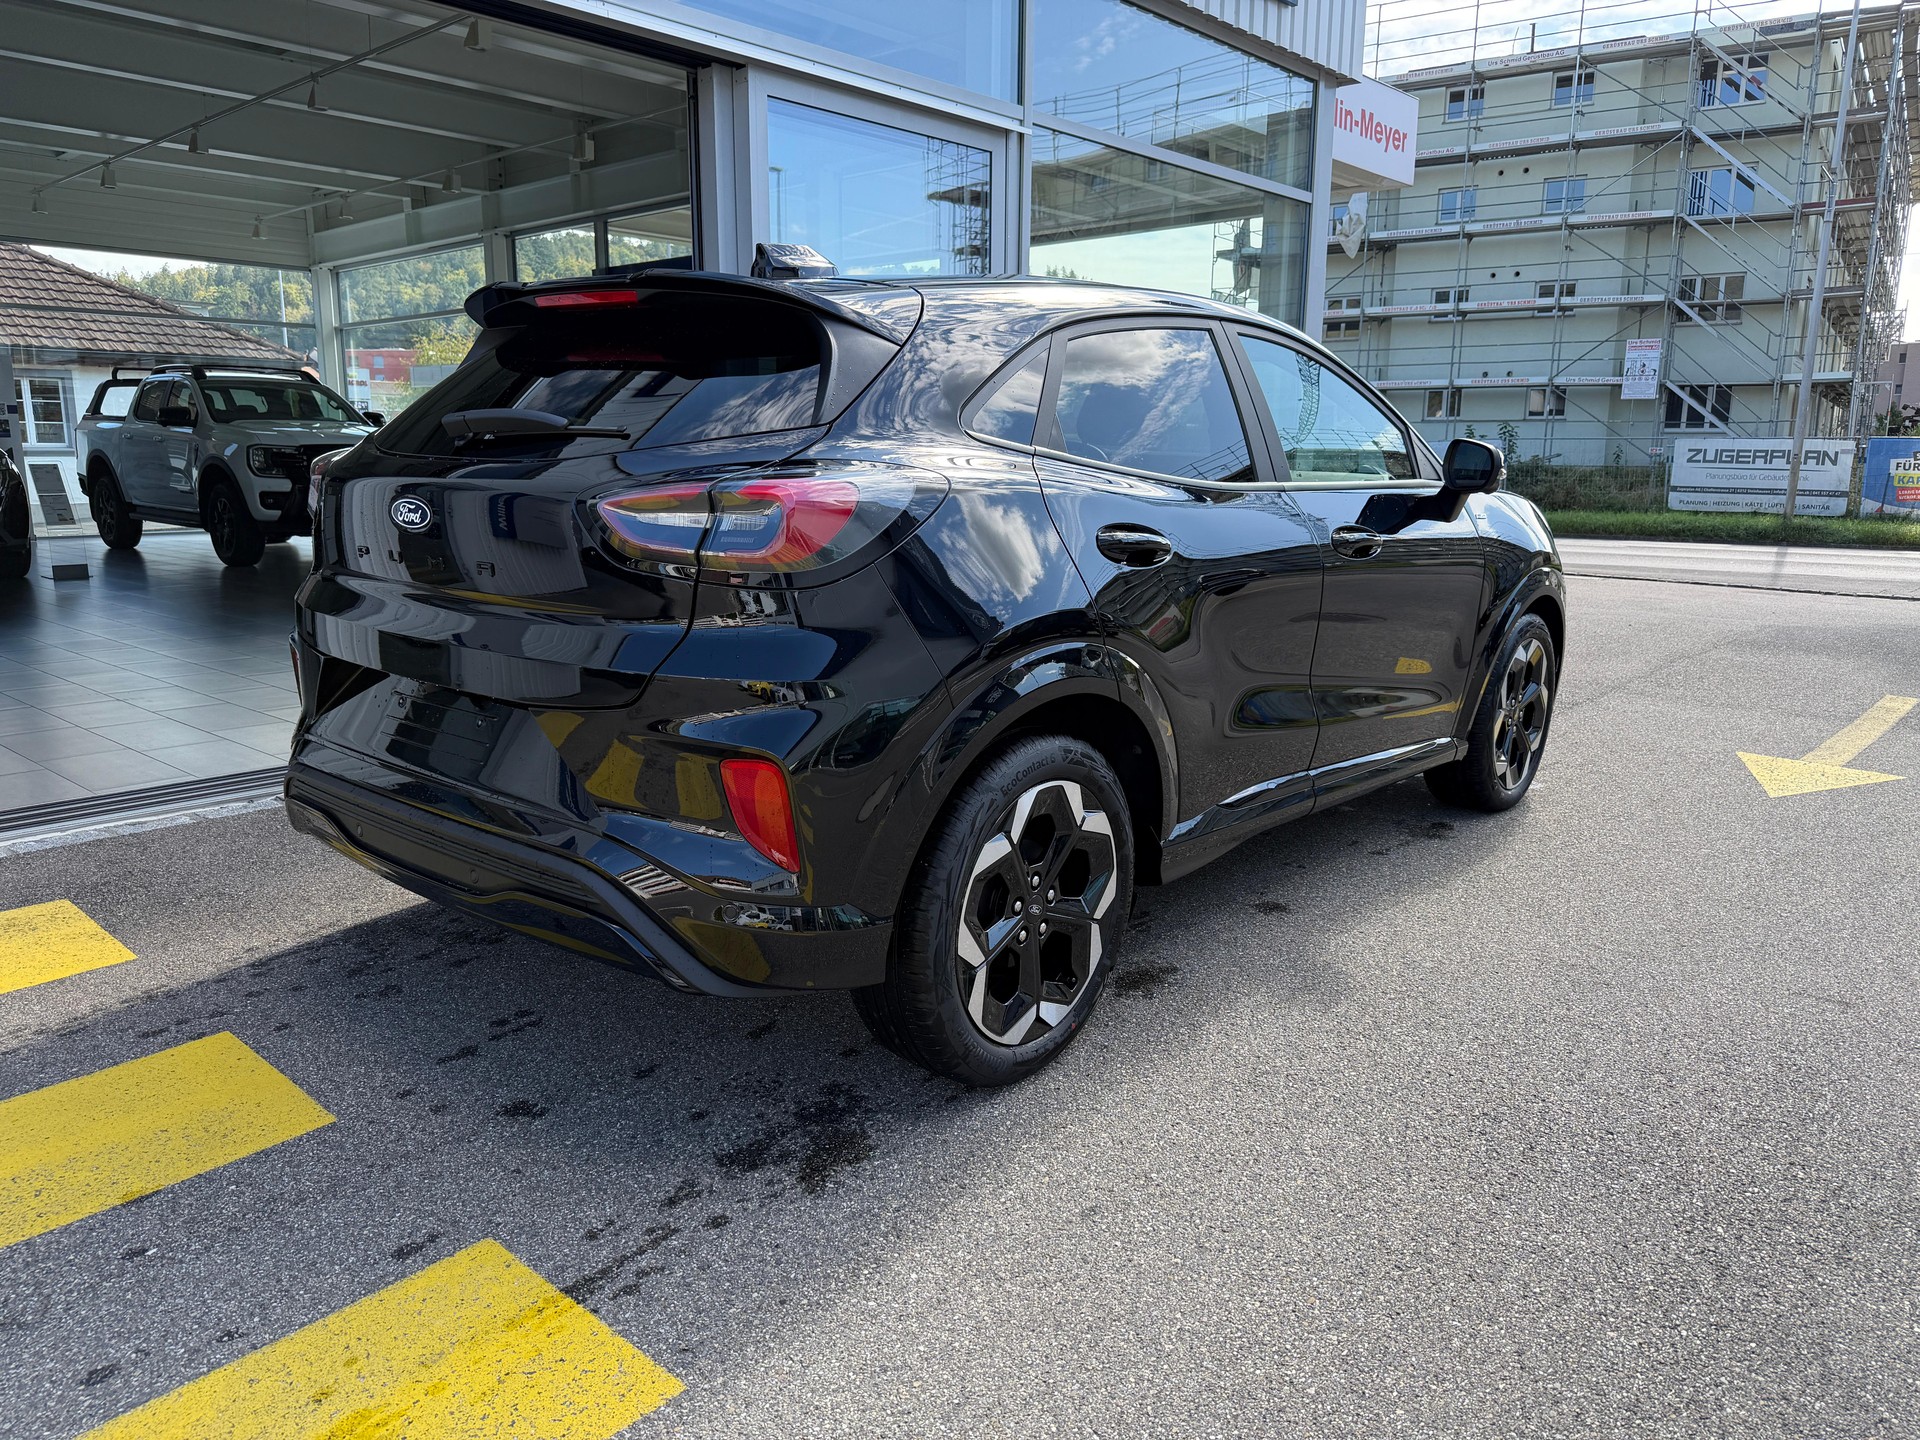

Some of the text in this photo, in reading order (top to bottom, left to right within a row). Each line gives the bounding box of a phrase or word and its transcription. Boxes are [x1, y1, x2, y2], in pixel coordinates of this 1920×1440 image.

[1499, 56, 1522, 65] Schmid
[1686, 448, 1839, 466] ZUGERPLAN
[1896, 460, 1920, 471] FÜR
[1705, 472, 1748, 481] Planungsbüro
[1758, 473, 1809, 481] Gebäudenik
[398, 503, 422, 523] Ford
[1000, 755, 1049, 798] EcoContact
